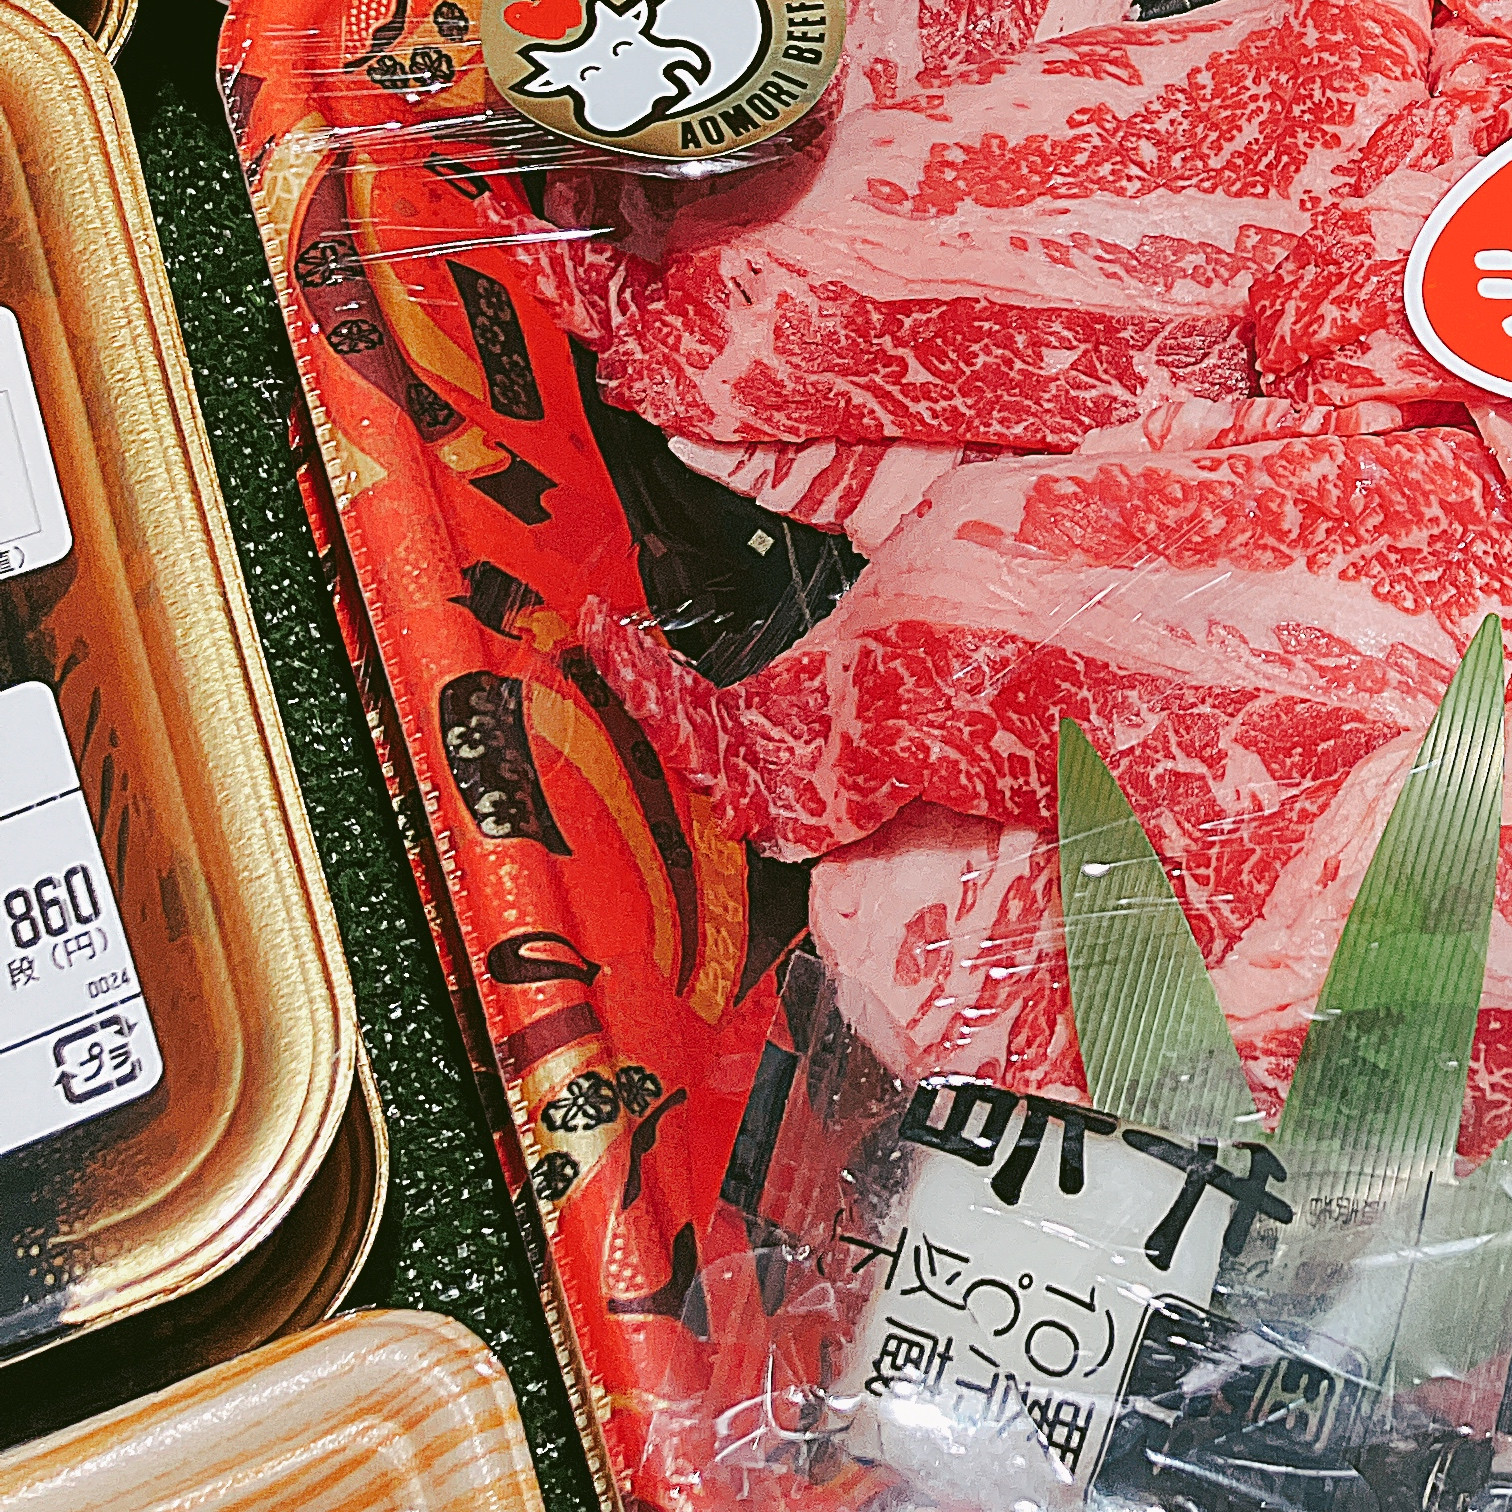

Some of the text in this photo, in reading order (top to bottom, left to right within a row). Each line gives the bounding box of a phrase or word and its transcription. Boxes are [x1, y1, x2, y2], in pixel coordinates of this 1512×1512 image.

[681, 1, 827, 150] AOMORI BEEF
[4, 863, 101, 950] 860
[86, 968, 131, 999] 0024
